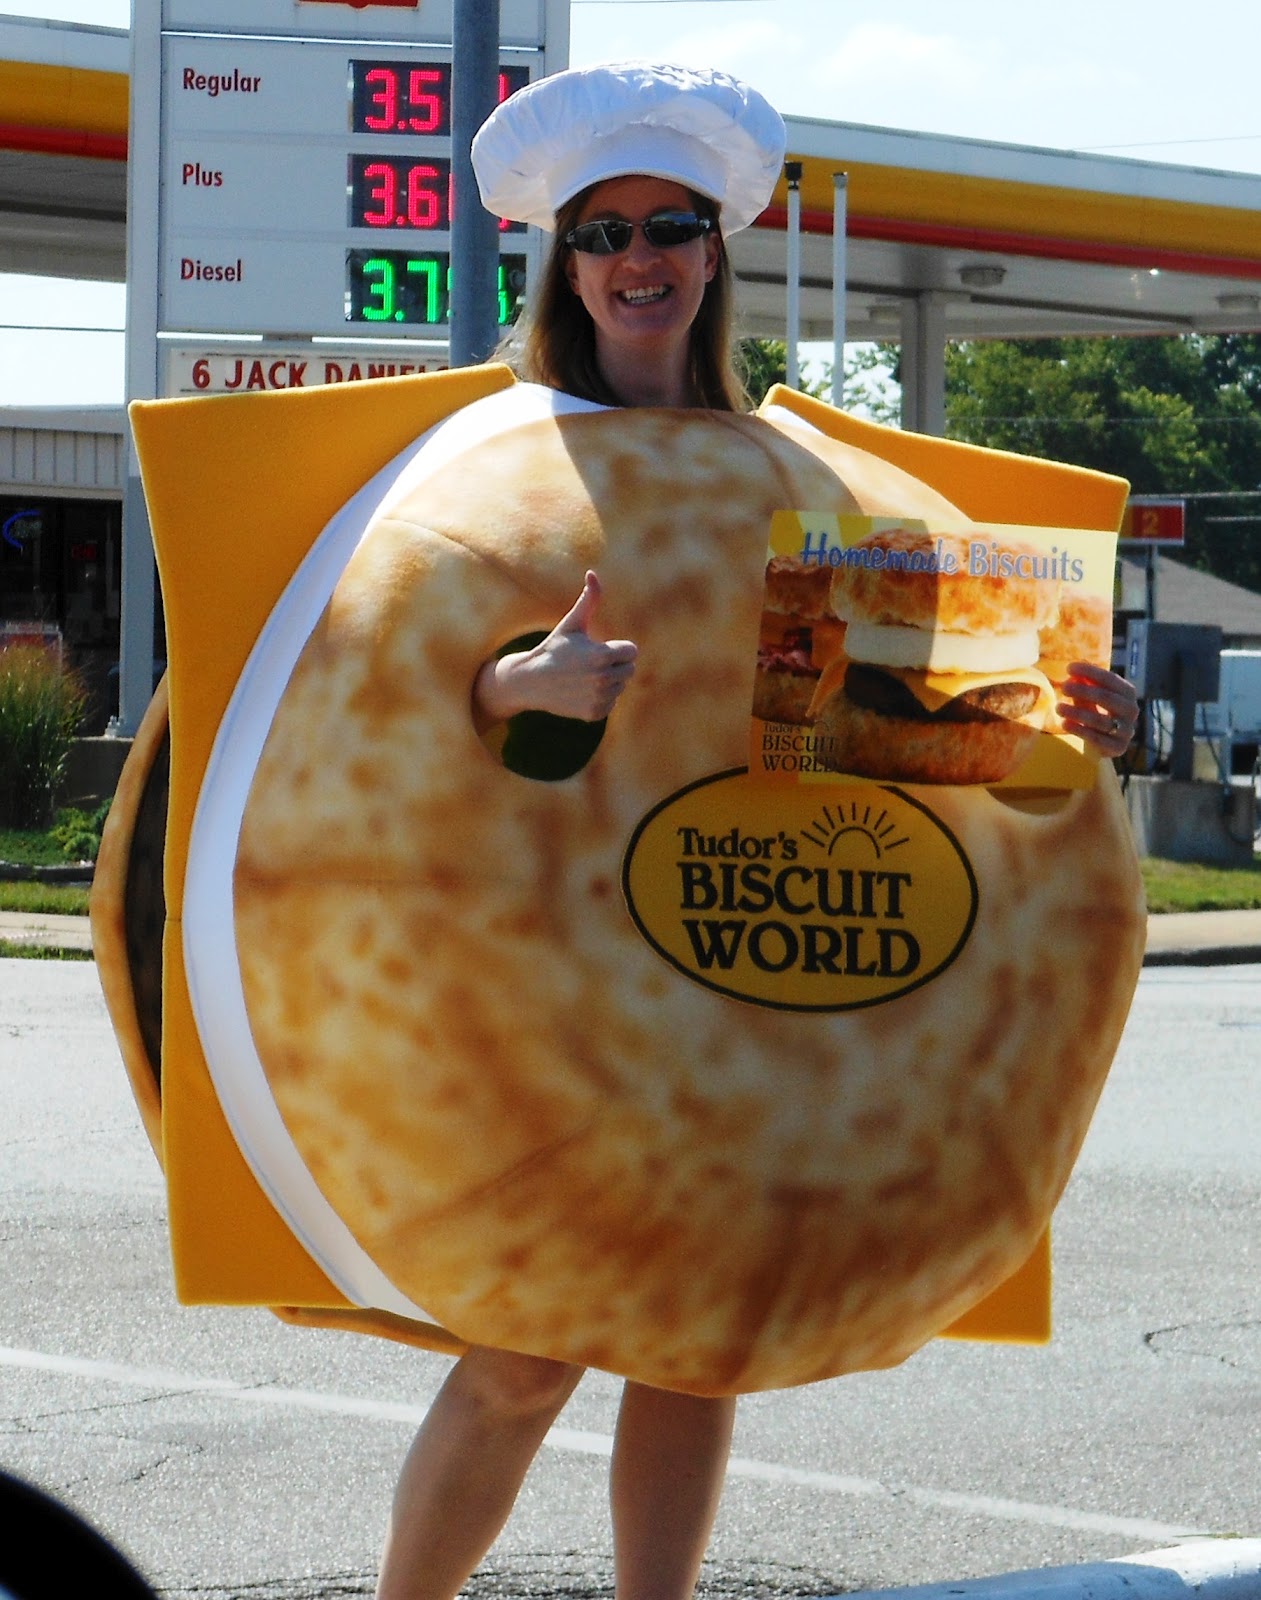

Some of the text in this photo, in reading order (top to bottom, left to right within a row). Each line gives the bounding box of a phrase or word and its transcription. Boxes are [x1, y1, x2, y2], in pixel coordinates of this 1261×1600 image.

[183, 68, 261, 97] Regular
[182, 163, 223, 187] Plus
[180, 259, 242, 282] Diesel
[192, 359, 211, 389] 6
[225, 360, 307, 390] JACK
[801, 532, 1084, 582] Homemade Biscuits
[762, 734, 839, 752] BISCUIT
[677, 827, 798, 860] Tudor's
[677, 862, 912, 919] BISCUIT
[682, 920, 921, 978] WORLD
